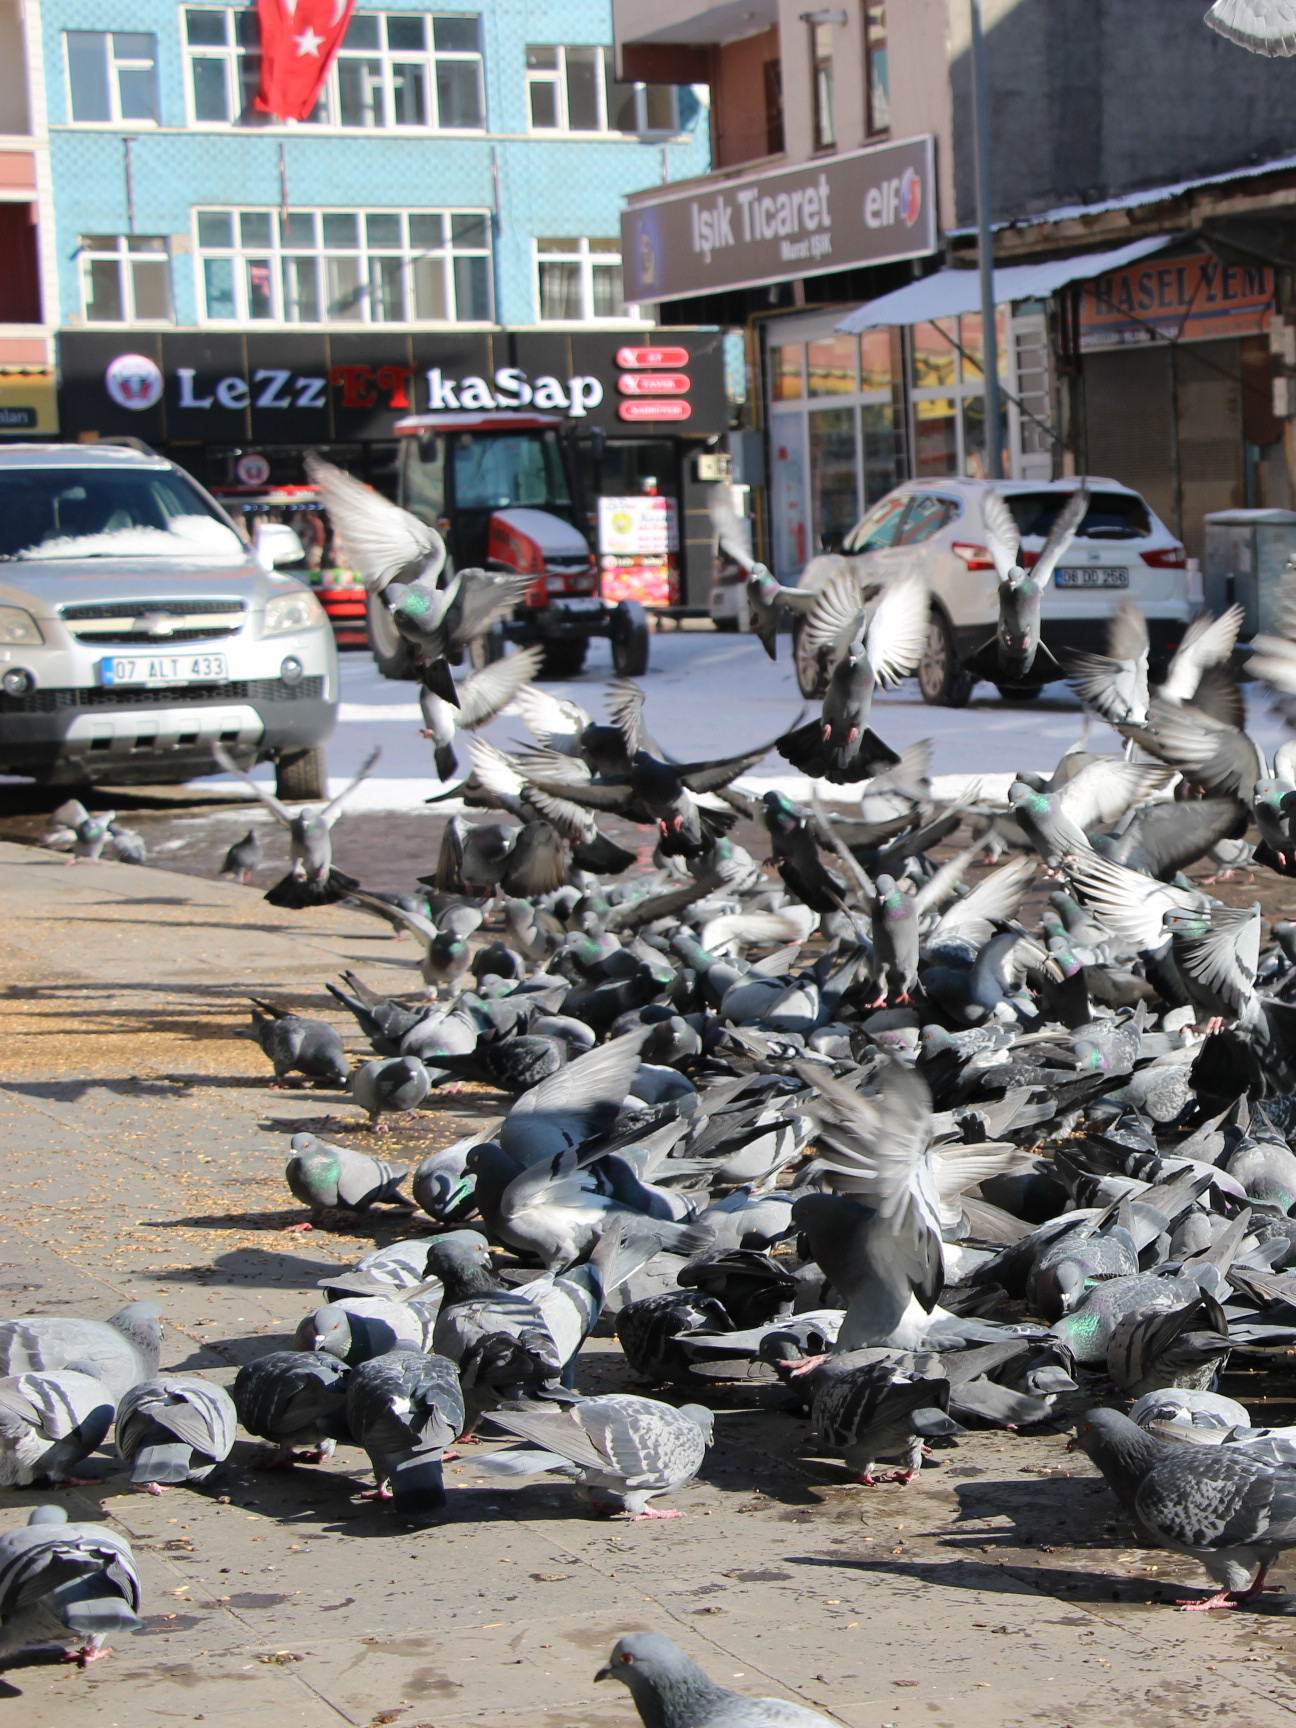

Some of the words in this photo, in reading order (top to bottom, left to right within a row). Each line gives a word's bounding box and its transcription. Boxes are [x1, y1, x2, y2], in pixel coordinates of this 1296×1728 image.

[736, 173, 832, 242] Ticaret
[864, 177, 901, 229] elf
[1095, 265, 1194, 318] HASEL
[1199, 262, 1268, 303] YEM
[426, 367, 604, 418] kaSap
[116, 660, 136, 680] 07
[148, 658, 180, 678] ALT
[191, 657, 223, 676] 433
